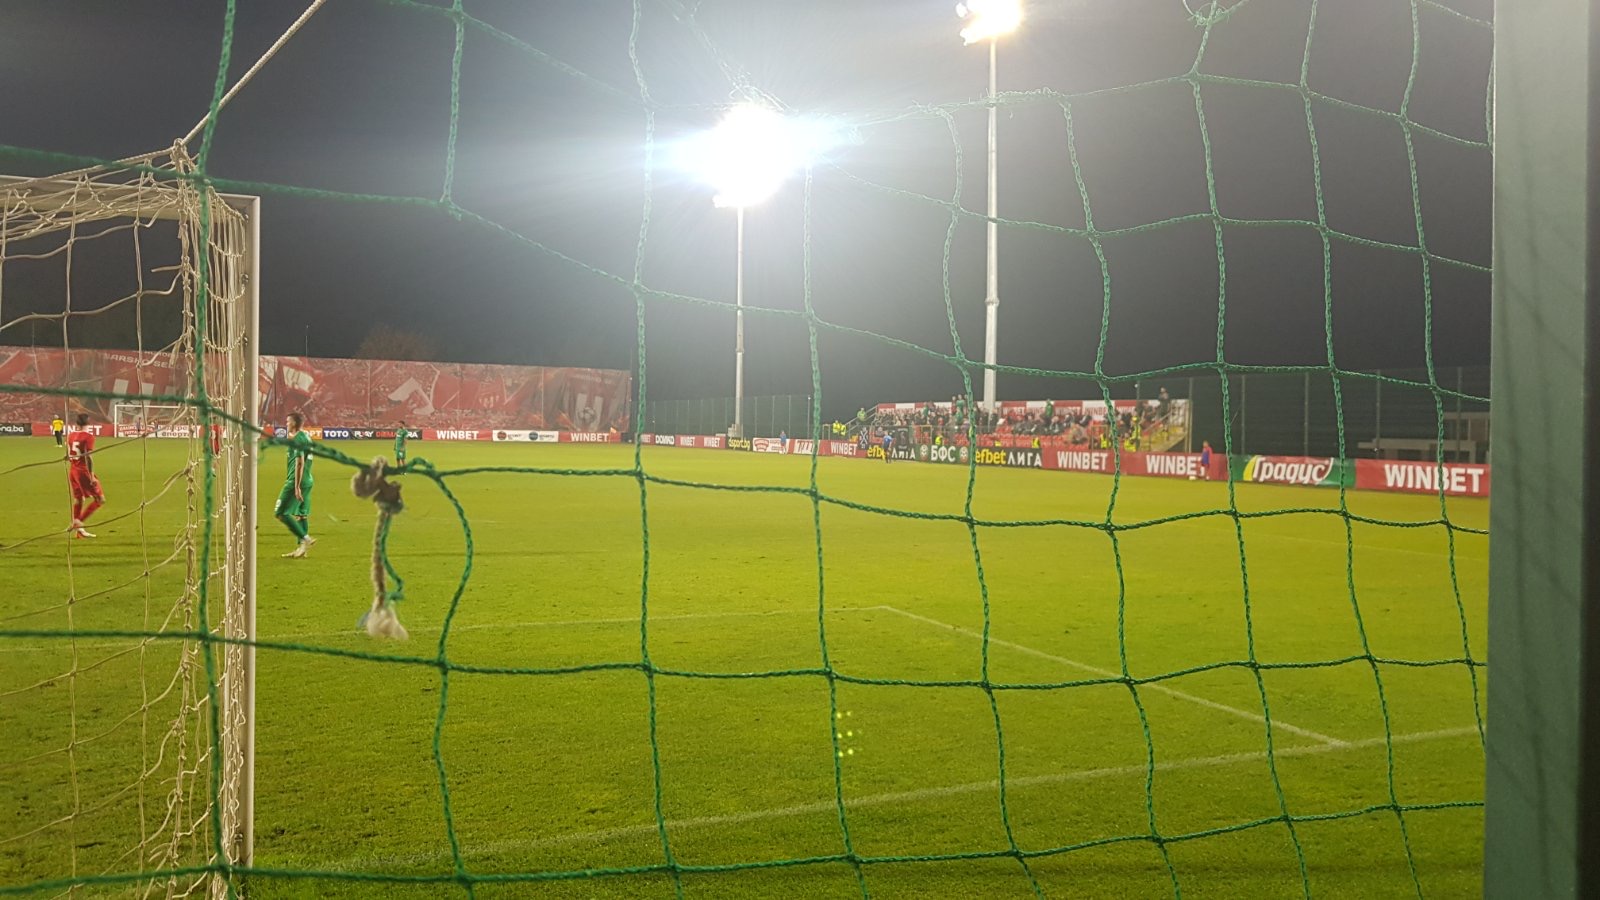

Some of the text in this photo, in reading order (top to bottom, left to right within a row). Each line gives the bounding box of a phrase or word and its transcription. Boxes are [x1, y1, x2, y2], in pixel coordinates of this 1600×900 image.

[436, 430, 479, 440] WINBET
[571, 432, 609, 442] WINBET
[830, 442, 857, 456] WINBET
[930, 445, 956, 462] БФС
[975, 449, 1042, 467] efbet ЛИГА
[1057, 451, 1108, 470] WINBET
[1384, 463, 1484, 493] WINBET
